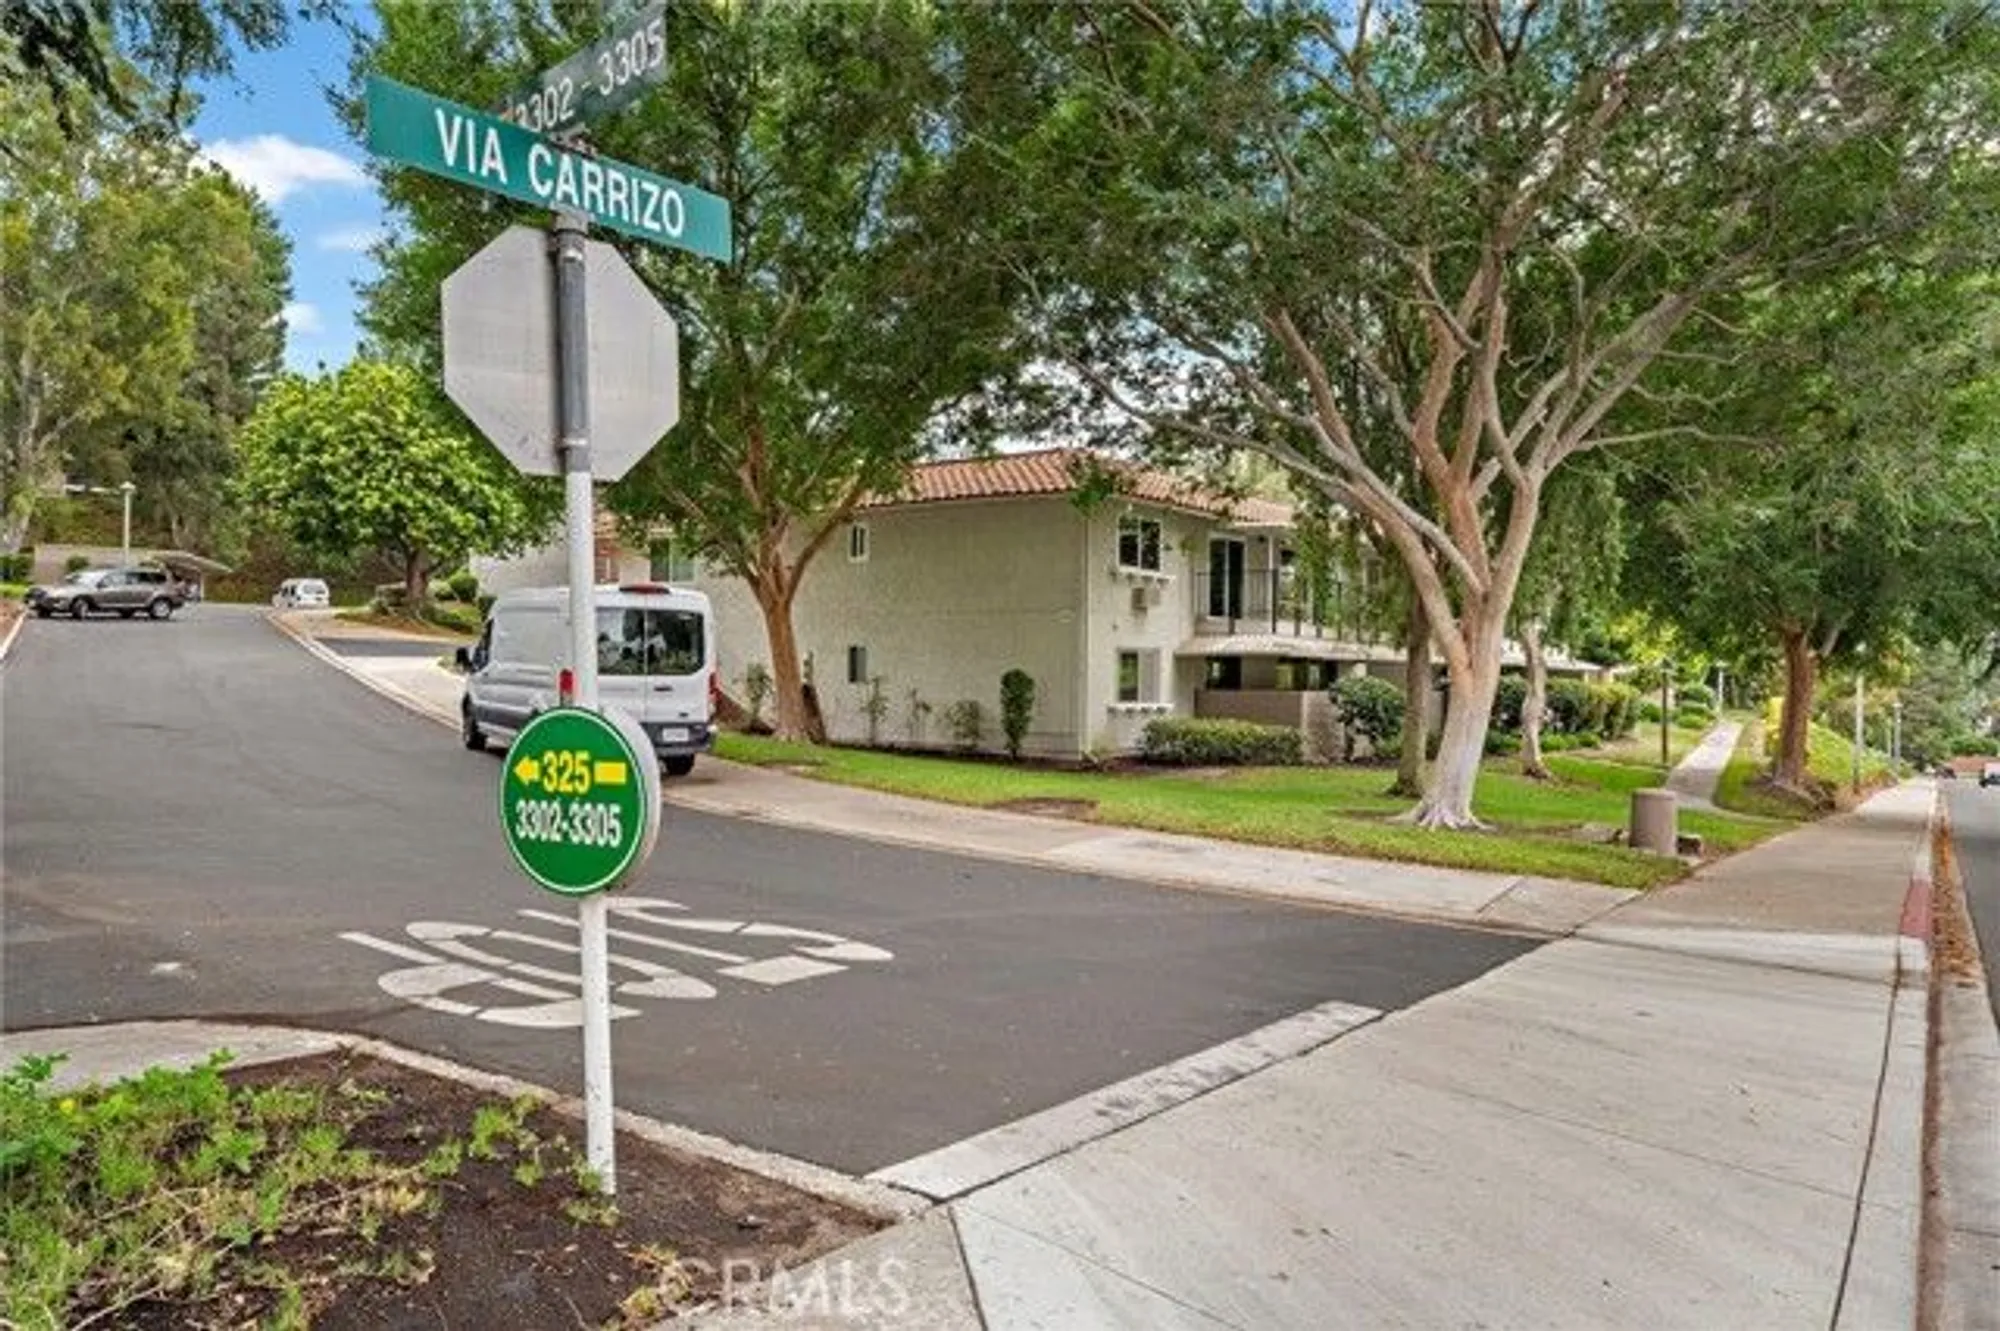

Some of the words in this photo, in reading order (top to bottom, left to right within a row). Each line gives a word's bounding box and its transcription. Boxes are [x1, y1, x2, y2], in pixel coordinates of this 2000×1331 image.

[599, 18, 663, 96] 3305
[434, 108, 507, 184] VIA
[528, 143, 684, 237] CARRIZO
[543, 750, 591, 794] 325
[515, 800, 622, 847] 3302-3305
